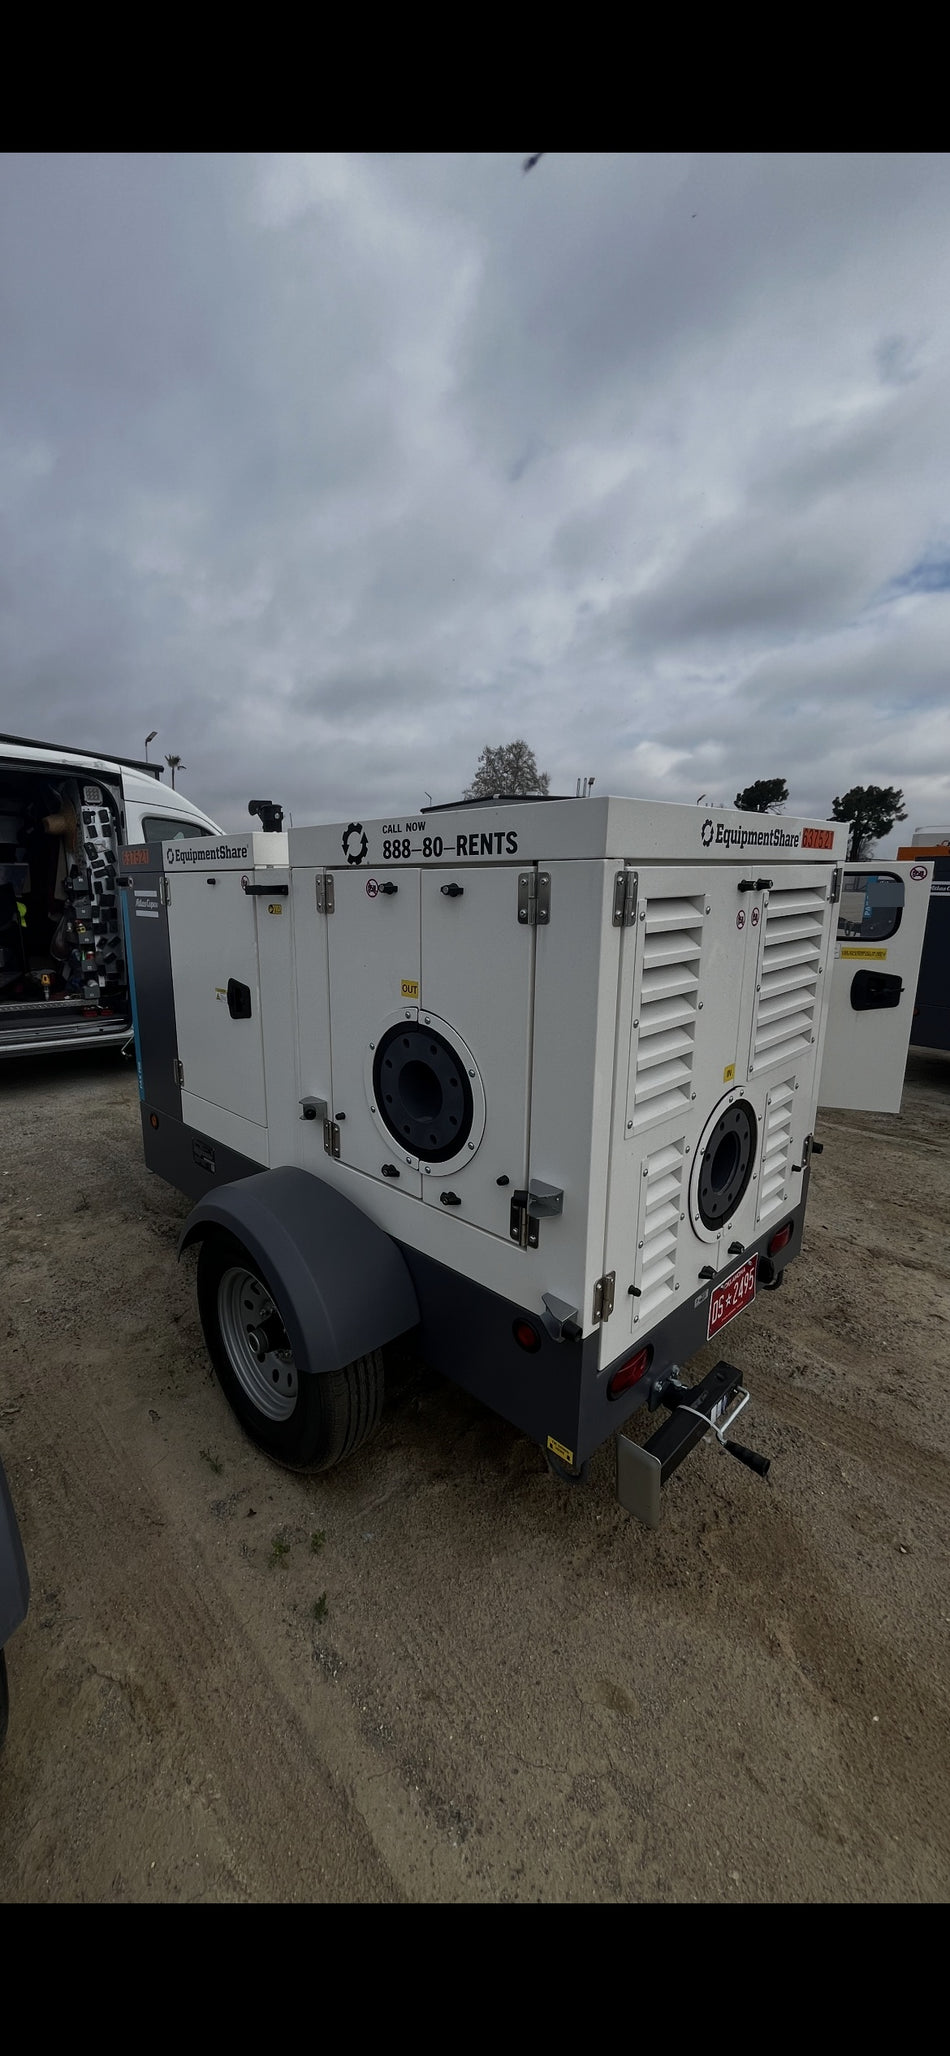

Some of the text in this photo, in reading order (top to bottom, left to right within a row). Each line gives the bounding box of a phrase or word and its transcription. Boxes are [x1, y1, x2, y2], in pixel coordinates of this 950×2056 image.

[382, 821, 426, 834] CALL NOW
[715, 823, 799, 849] EquipmentShare
[175, 845, 248, 864] EquipmentShare
[402, 984, 418, 994] OUT
